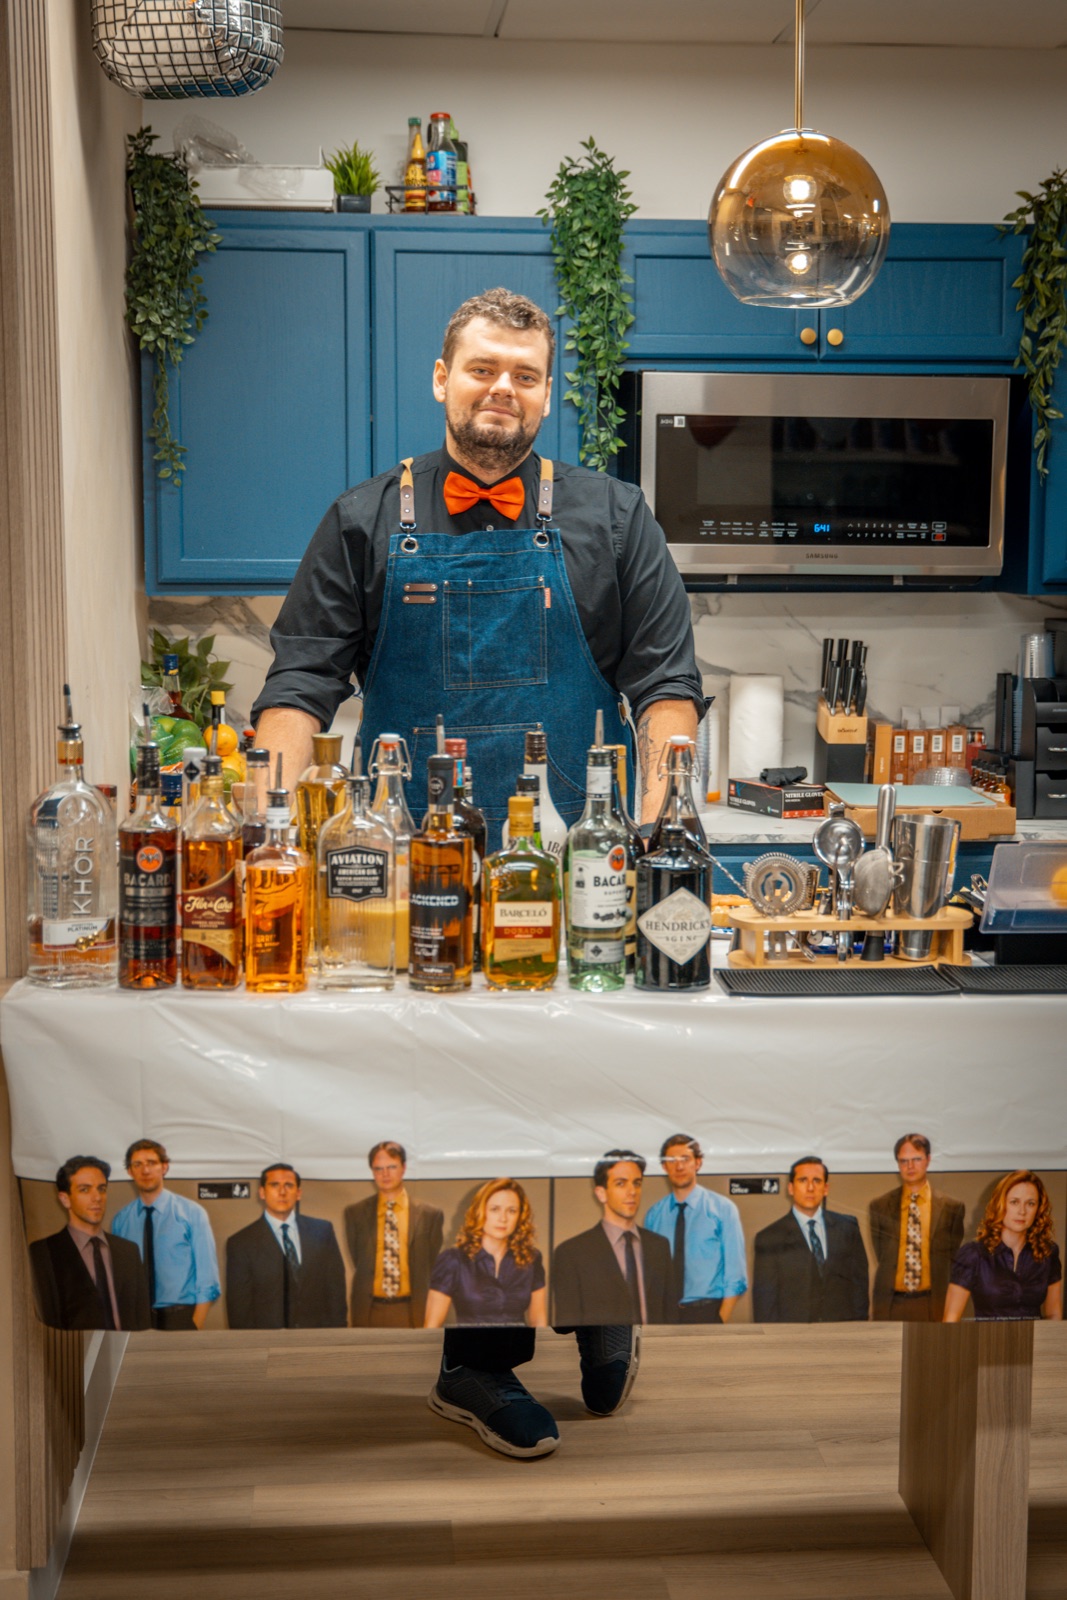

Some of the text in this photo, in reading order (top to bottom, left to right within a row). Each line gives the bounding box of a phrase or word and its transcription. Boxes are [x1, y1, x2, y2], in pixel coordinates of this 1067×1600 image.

[331, 854, 384, 865] AVIATION
[72, 836, 95, 916] KHOR
[499, 907, 547, 918] BARCELÓ
[67, 924, 98, 932] PLATINUM
